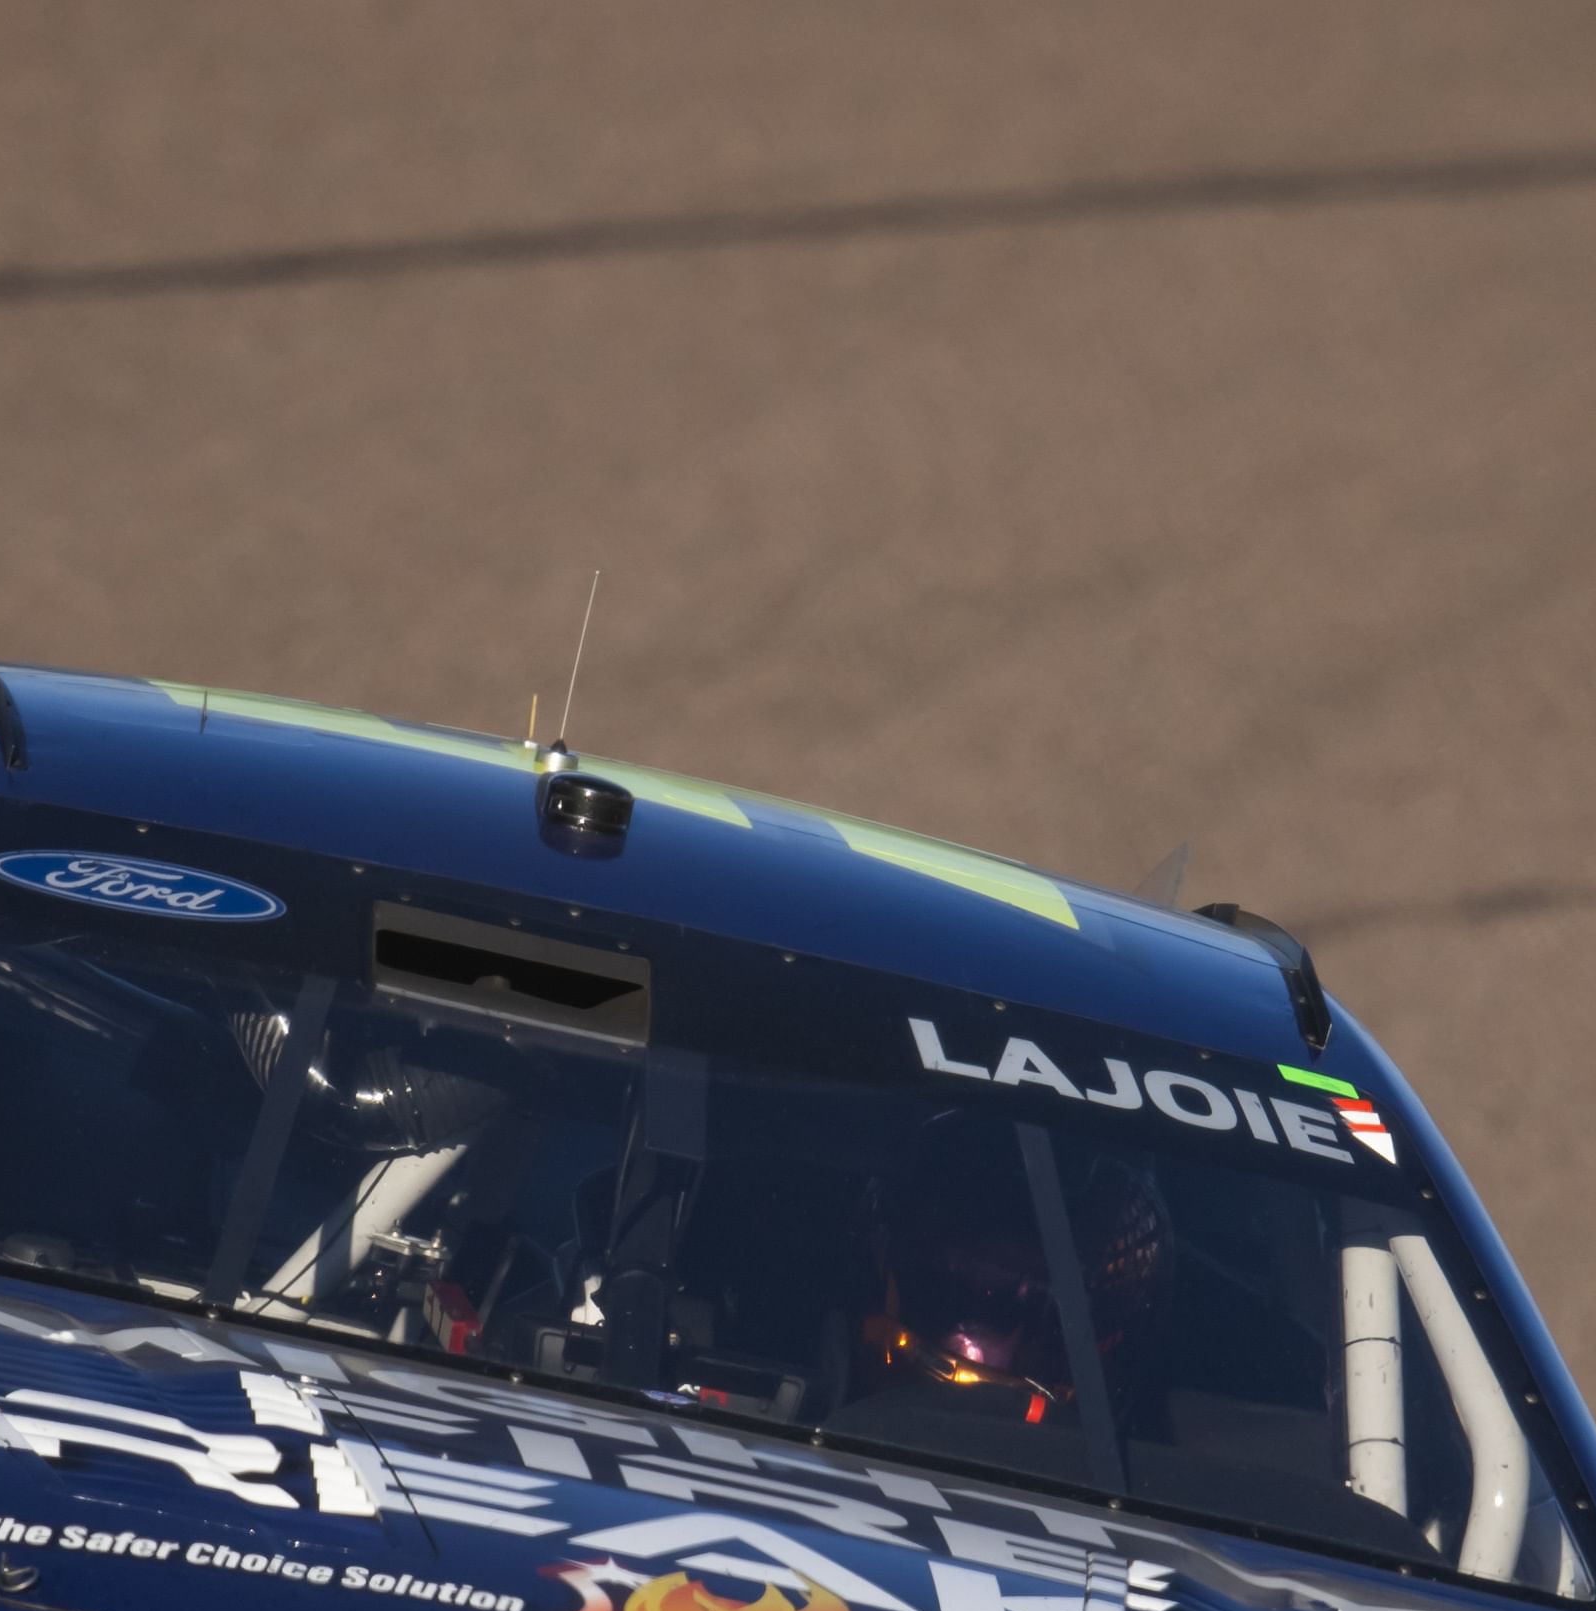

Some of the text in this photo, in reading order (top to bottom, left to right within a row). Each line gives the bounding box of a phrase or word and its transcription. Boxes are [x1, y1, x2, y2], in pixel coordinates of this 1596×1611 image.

[45, 859, 225, 911] Ford
[907, 1016, 1355, 1165] LAJOIE
[239, 1369, 1179, 1606] FIRE
[58, 1525, 180, 1560] Safer
[185, 1542, 334, 1585] Choice
